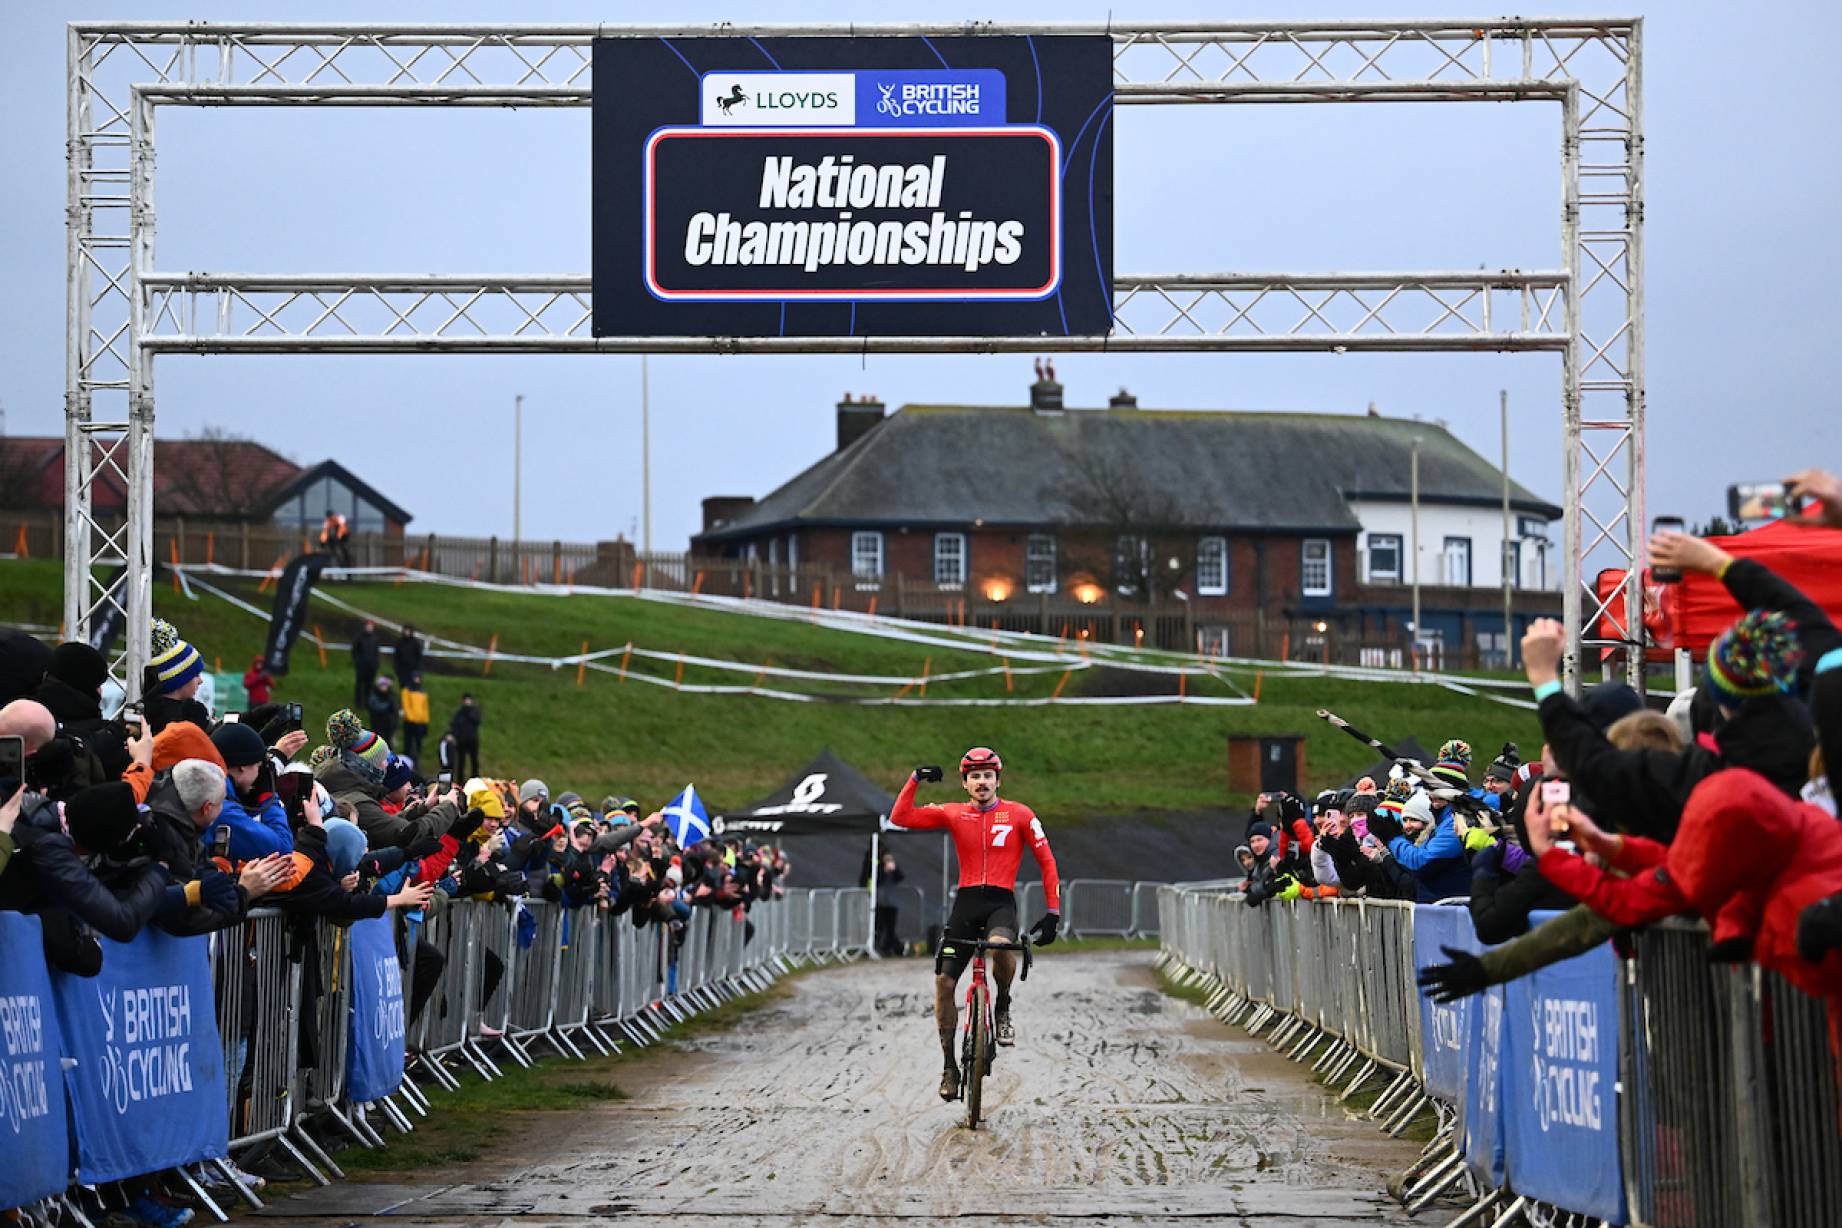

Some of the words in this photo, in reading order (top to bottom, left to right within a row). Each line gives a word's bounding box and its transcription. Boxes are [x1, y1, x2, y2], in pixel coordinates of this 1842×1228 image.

[756, 92, 838, 109] LLOYDS
[902, 84, 980, 100] BRITISH
[902, 99, 980, 115] CYCLING
[759, 155, 947, 209] National
[685, 211, 1025, 272] Championships
[990, 824, 1013, 847] 7
[123, 985, 191, 1043] BRITISH
[1544, 999, 1599, 1064] BRITISH
[128, 1042, 193, 1101] CYCLING
[1549, 1065, 1601, 1131] CYCLING
